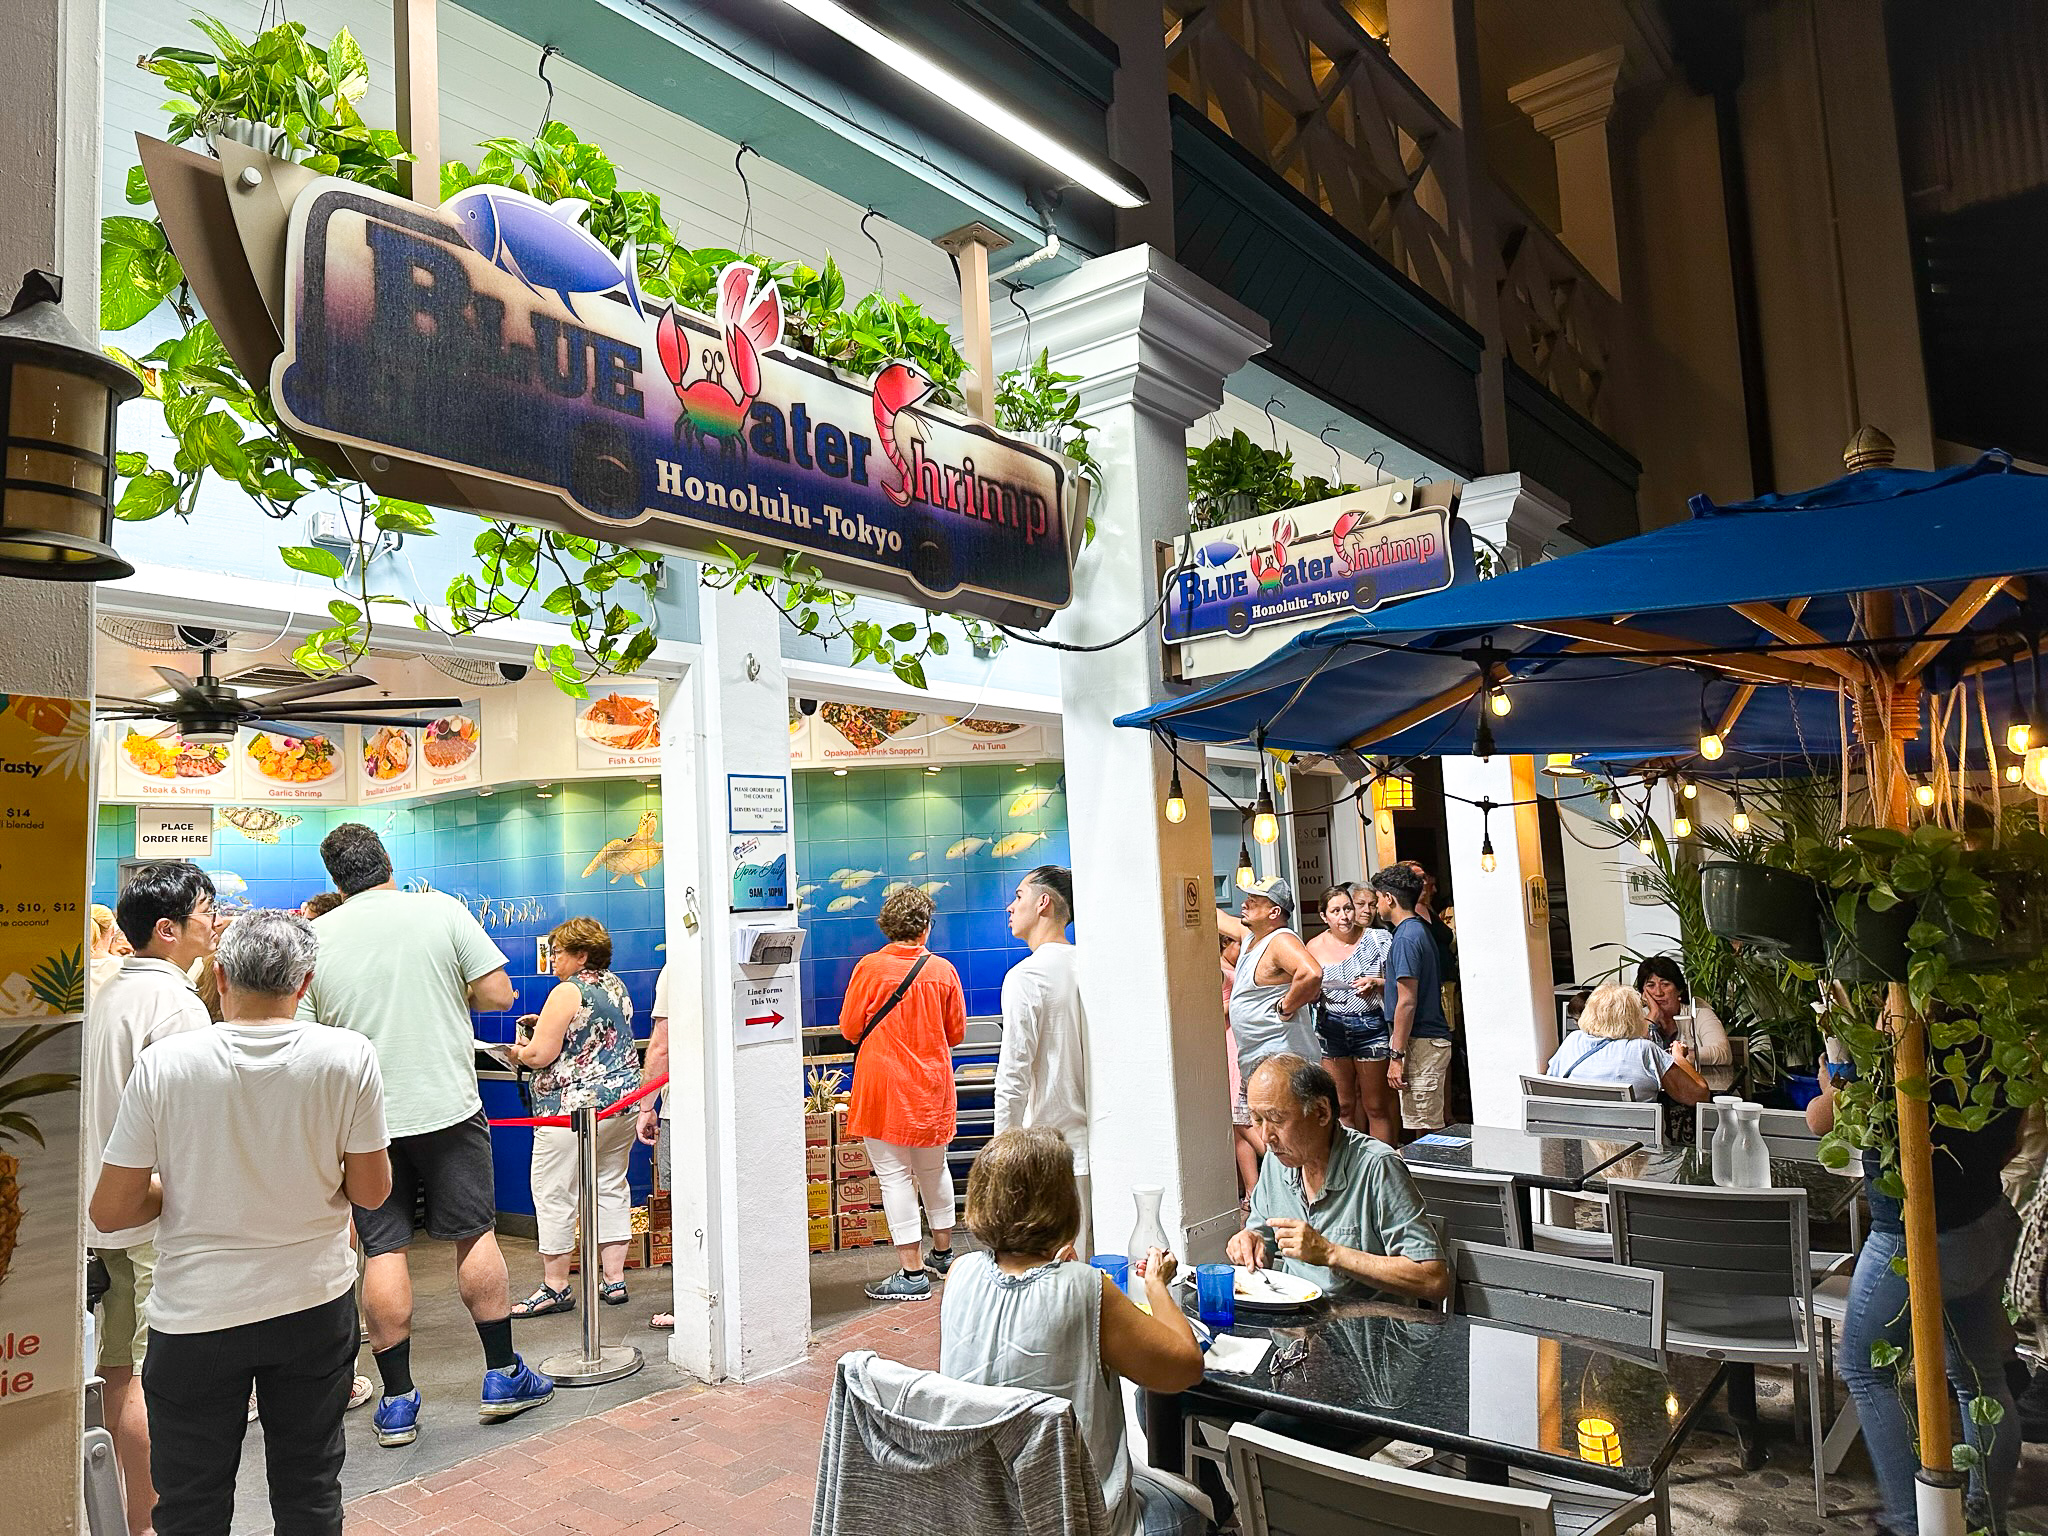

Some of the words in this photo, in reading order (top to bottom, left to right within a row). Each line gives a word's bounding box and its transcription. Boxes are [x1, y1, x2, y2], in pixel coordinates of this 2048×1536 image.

[366, 219, 645, 420] BLUE
[655, 458, 902, 556] Honolulu-Tokyo
[1178, 570, 1249, 612] BLUE
[1252, 589, 1350, 619] Honolulu-Tokyo
[868, 748, 888, 757] (Pink
[888, 746, 924, 756] Snapper)
[972, 743, 986, 751] Ahi
[987, 742, 1007, 750] Tuna
[608, 757, 627, 765] Fish
[628, 756, 636, 764] &
[637, 756, 661, 765] Chips
[143, 786, 169, 794] Steak
[170, 786, 177, 794] &
[179, 787, 211, 796] Shrimp
[269, 789, 293, 797] Garlic
[294, 789, 322, 798] Shrimp
[6, 807, 31, 818] $14
[6, 820, 45, 829] blended
[161, 823, 194, 831] PLACE
[142, 835, 178, 843] ORDER
[181, 835, 209, 843] HERE
[1297, 855, 1319, 869] 2nd
[733, 861, 759, 881] Open
[759, 860, 785, 881] Daily
[748, 887, 764, 898] 9AM
[768, 887, 784, 897] 10PM
[17, 902, 46, 913] $10,
[53, 902, 76, 912] $12
[12, 918, 49, 927] coconut
[747, 988, 762, 996] Line
[762, 987, 783, 995] Forms
[750, 998, 765, 1006] This
[766, 997, 780, 1005] Way
[843, 1151, 864, 1161] Dole
[844, 1184, 864, 1195] Dole
[842, 1215, 868, 1228] Dole
